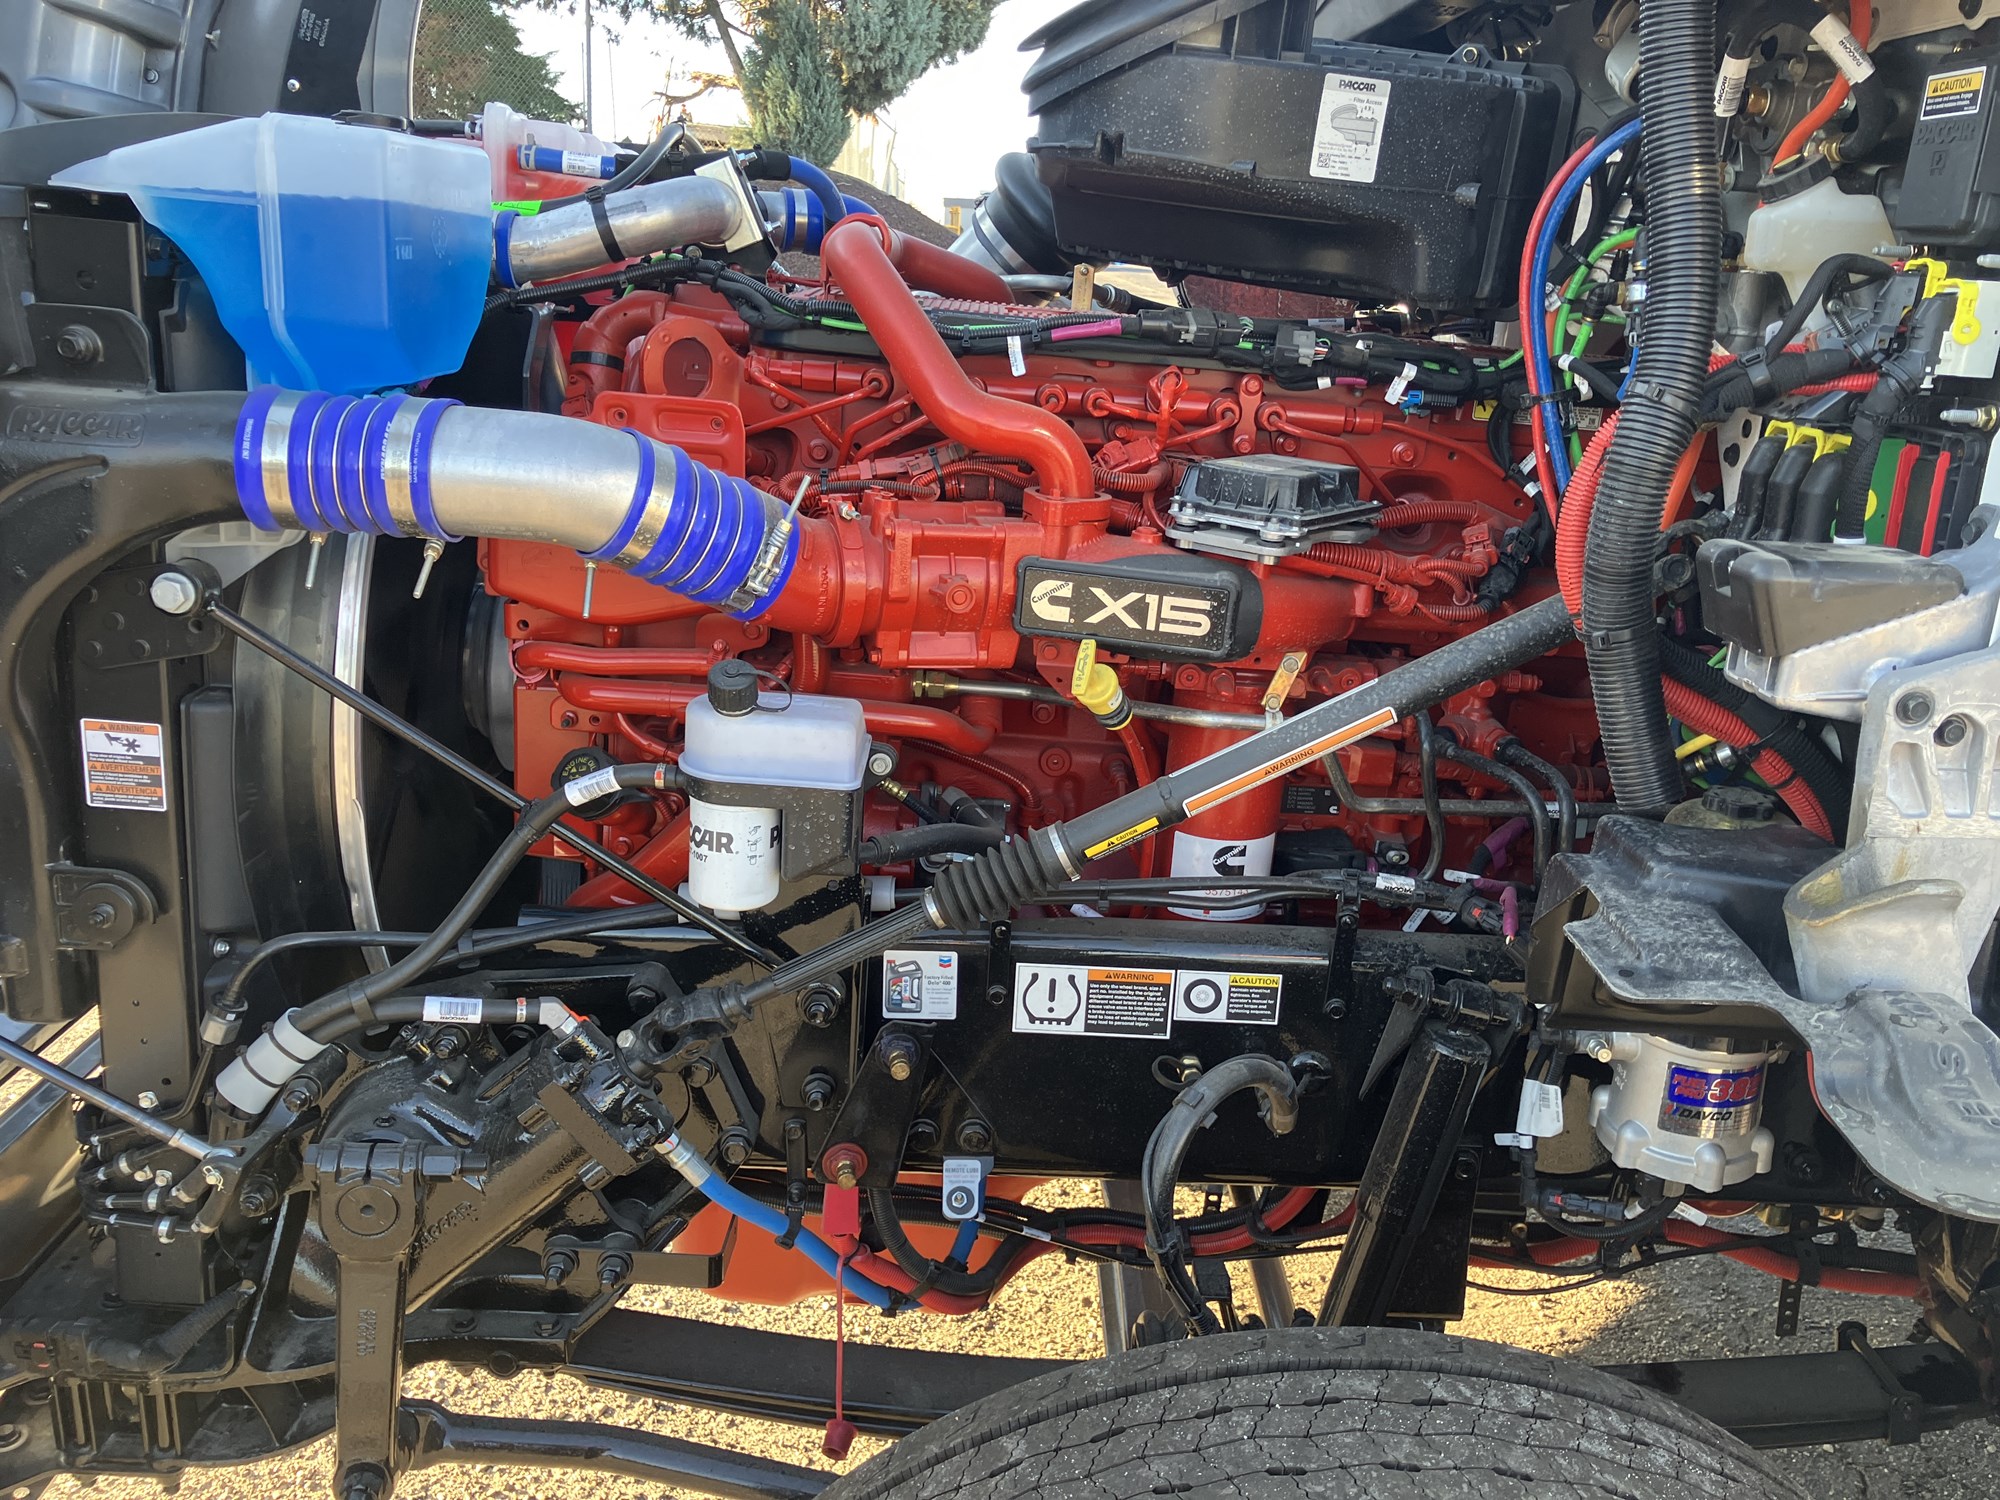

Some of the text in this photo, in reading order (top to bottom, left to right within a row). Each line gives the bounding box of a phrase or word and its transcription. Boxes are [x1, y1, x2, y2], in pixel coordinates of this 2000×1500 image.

[1838, 39, 1863, 67] PACCAR
[1339, 80, 1376, 92] PACCAR
[1716, 76, 1729, 105] PACCAR
[1940, 77, 1973, 92] CAUTION
[1366, 98, 1382, 106] Access
[17, 408, 140, 440] PACCAR
[1083, 587, 1211, 637] X15
[108, 723, 145, 732] WARNING
[562, 757, 596, 776] ENGINE OIL
[1268, 748, 1314, 773] WARNING
[101, 763, 159, 774] AVERTISSEMENT
[106, 785, 157, 795] ADVERTENCIA
[1115, 828, 1138, 842] CAUTION
[1213, 845, 1244, 865] Cummins
[1113, 973, 1154, 981] WARNING
[1238, 977, 1278, 985] CAUTION
[1672, 1074, 1707, 1089] FUEL
[1675, 1086, 1705, 1099] PRO
[1679, 1108, 1733, 1121] DAVCO
